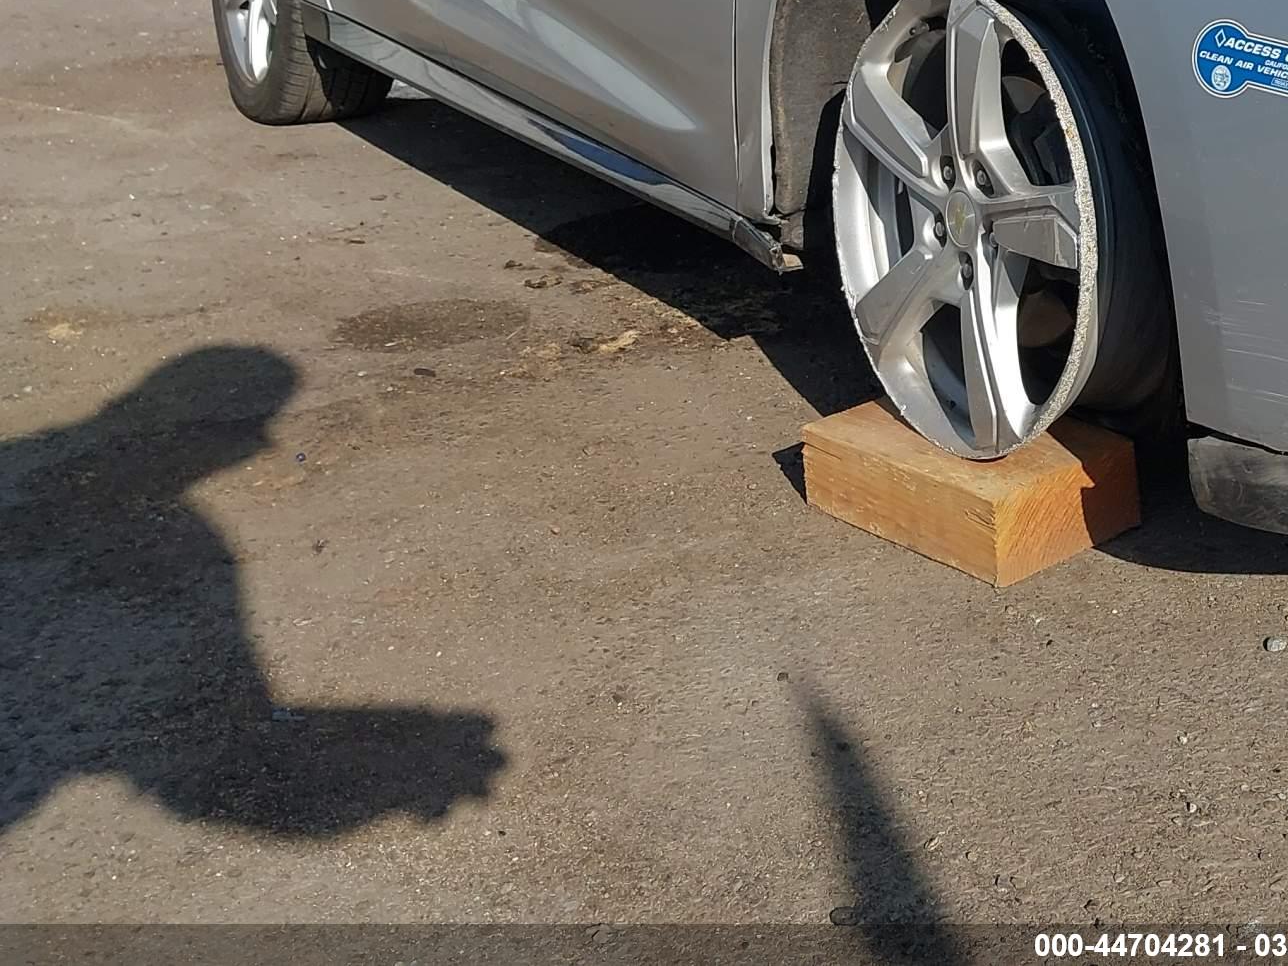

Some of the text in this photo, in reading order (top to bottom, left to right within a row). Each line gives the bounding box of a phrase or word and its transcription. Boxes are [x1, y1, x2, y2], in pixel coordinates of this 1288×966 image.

[1224, 37, 1282, 60] ACCESS
[1199, 50, 1233, 65] CLEAN
[1235, 60, 1254, 70] AIR
